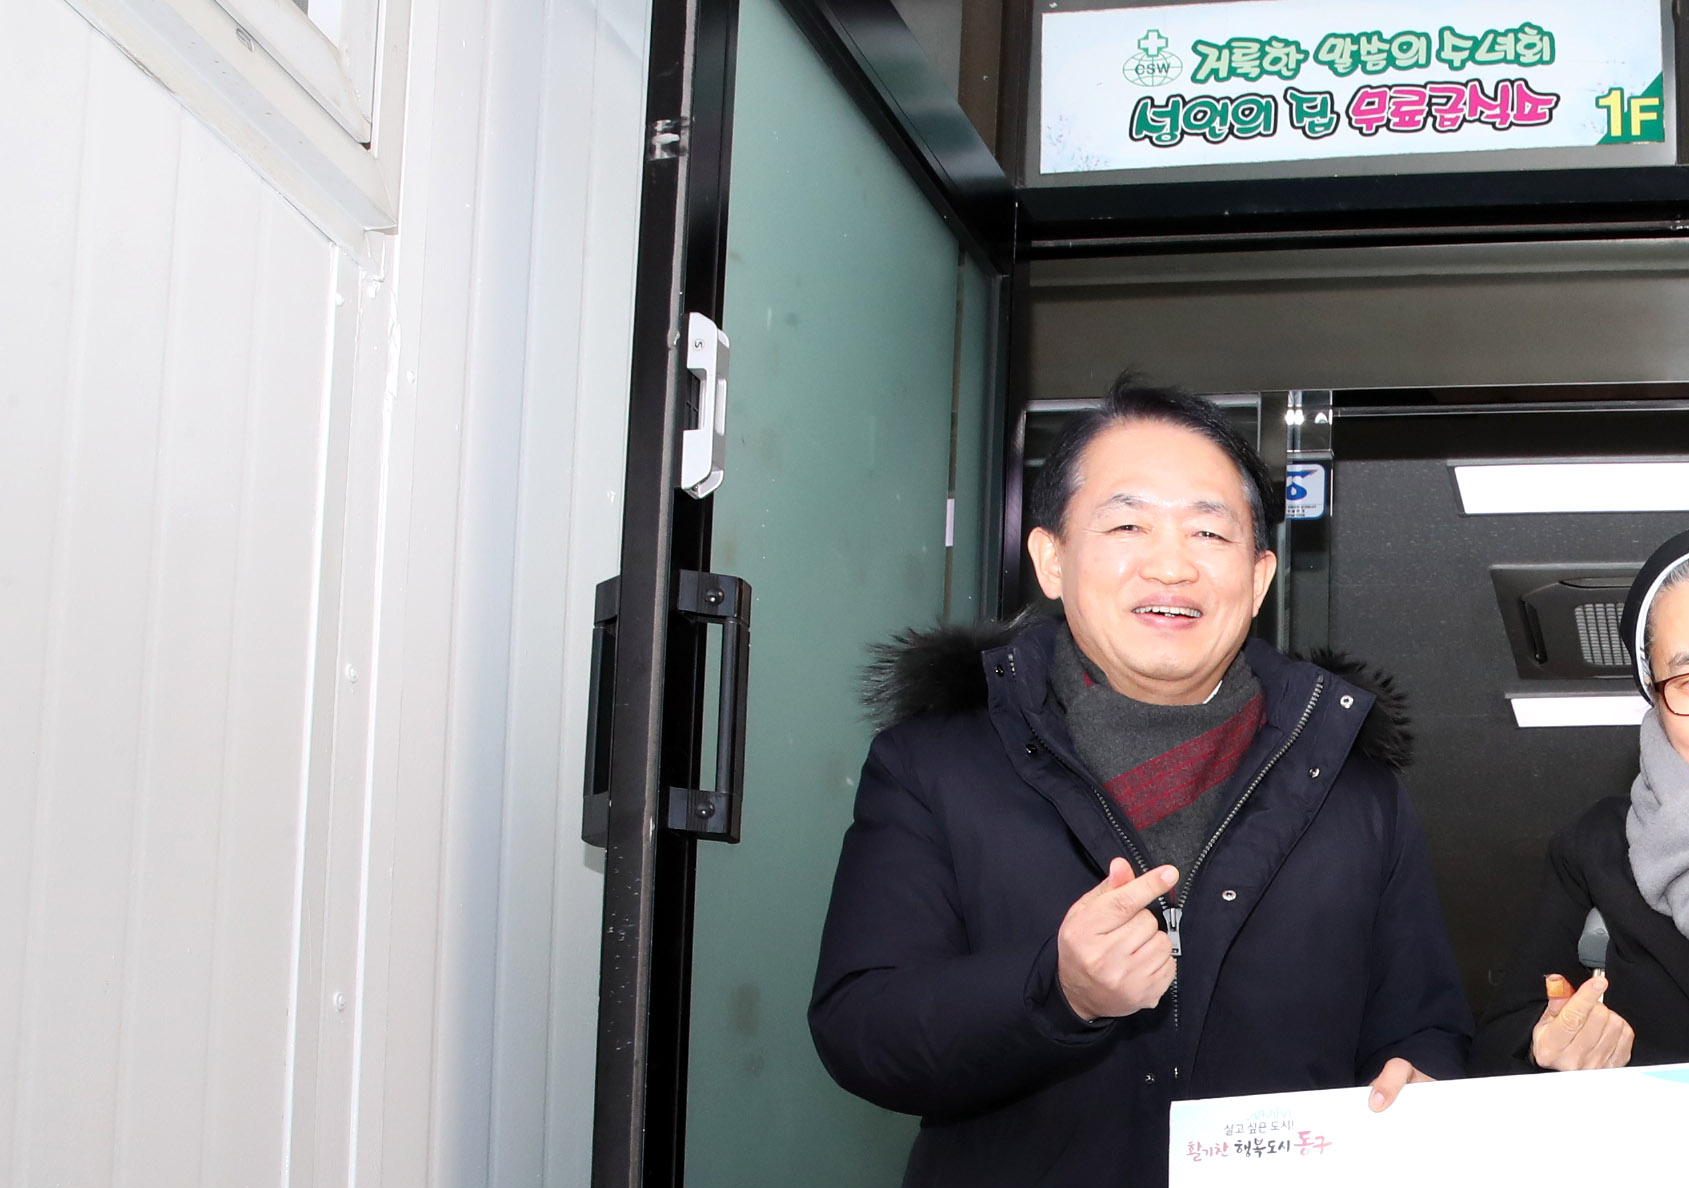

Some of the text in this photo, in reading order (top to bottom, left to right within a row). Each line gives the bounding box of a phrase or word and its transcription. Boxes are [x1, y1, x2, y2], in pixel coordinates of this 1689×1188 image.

[1134, 63, 1171, 76] CSW
[1191, 21, 1555, 84] 거룩한 말씀의 수녀회
[1129, 78, 1561, 148] 성언의 집 무료급식소
[1595, 87, 1660, 137] 1F
[1186, 1130, 1334, 1163] 활기찬 행복도시 동구
